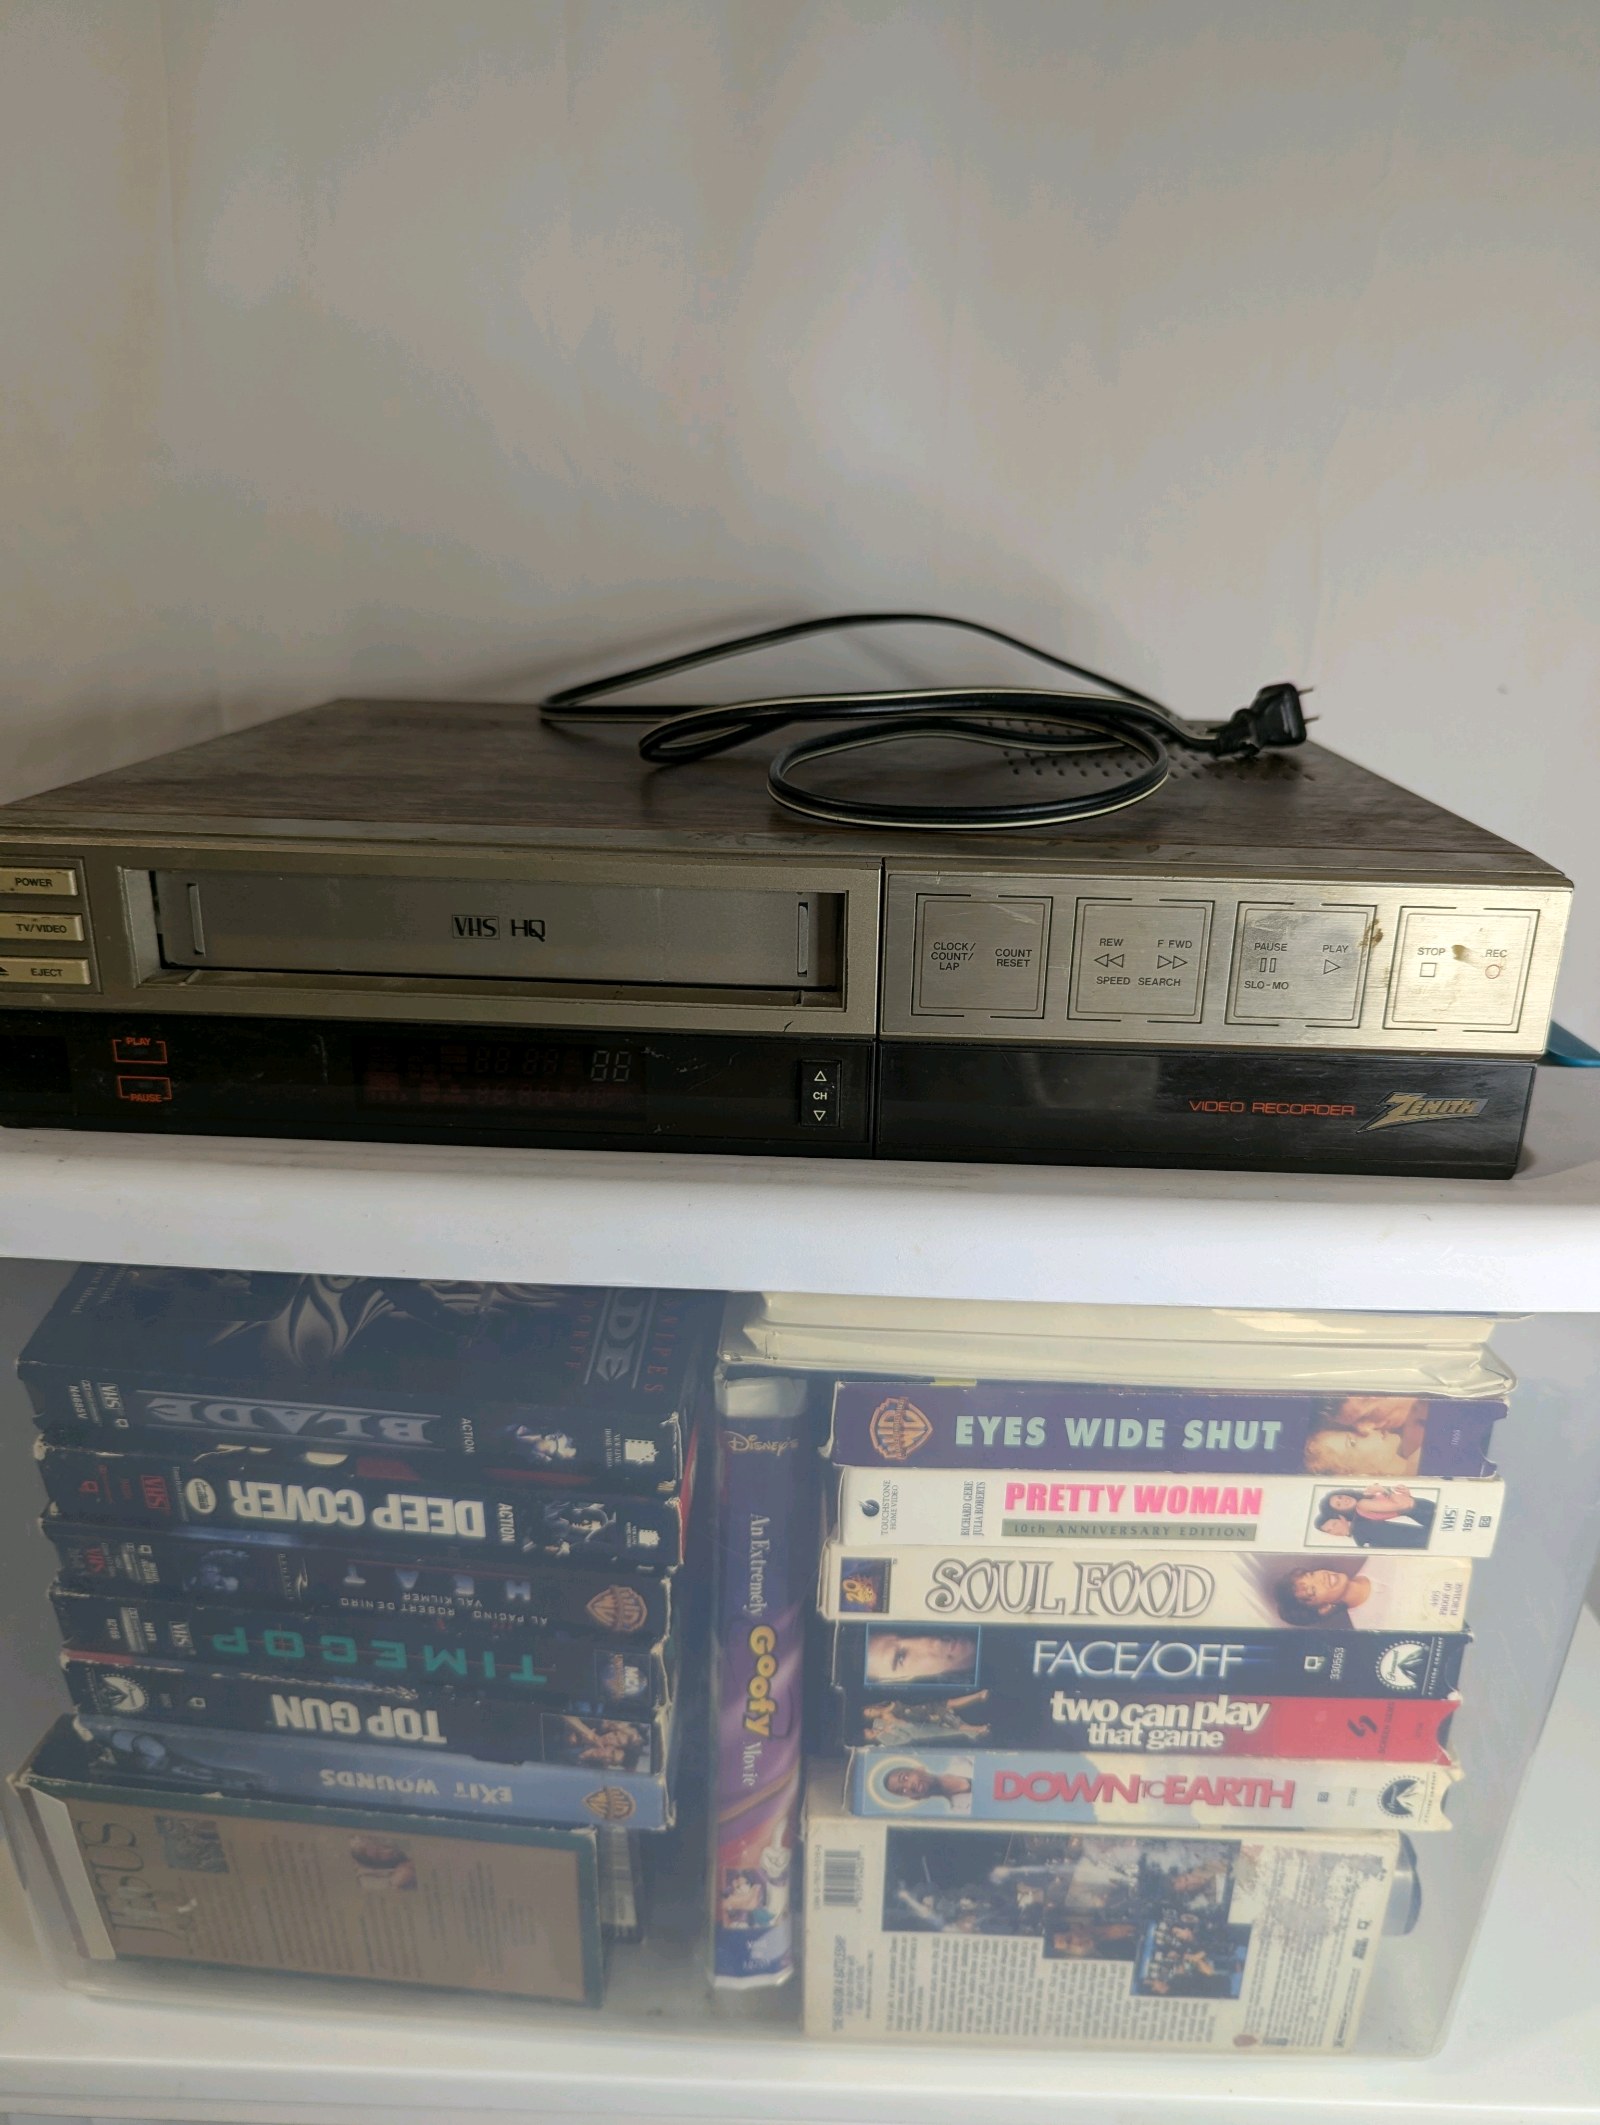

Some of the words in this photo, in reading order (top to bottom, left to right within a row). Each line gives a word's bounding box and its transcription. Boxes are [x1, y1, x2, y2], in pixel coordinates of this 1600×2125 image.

[15, 876, 53, 888] POWER
[16, 923, 67, 934] TV/VIDEO
[453, 916, 498, 939] VHS
[511, 918, 546, 942] HQ
[933, 942, 976, 952] CLOCK/
[995, 948, 1033, 959] COUNT
[1099, 937, 1124, 947] REW
[1157, 939, 1165, 949] F
[1168, 940, 1193, 950] FWD
[1253, 942, 1288, 952] PAUSE
[1322, 944, 1349, 954] PLAY
[1417, 947, 1446, 957] STOP
[1485, 949, 1508, 958] REC
[931, 952, 975, 962] COUNT/
[939, 961, 960, 971] LAP
[996, 958, 1031, 969] RESET
[30, 967, 64, 978] EJECT
[1096, 976, 1131, 986] SPEED
[1137, 977, 1182, 987] SEARCH
[125, 1036, 152, 1047] PLAY
[129, 1093, 163, 1103] PAUSE
[813, 1091, 828, 1100] CH
[1189, 1100, 1245, 1113] VIDEO
[1251, 1102, 1357, 1116] RECORDER
[99, 1383, 122, 1409] VHS
[146, 1397, 433, 1445] BLADE
[955, 1415, 1047, 1447] EYES
[1064, 1417, 1166, 1449] WIDE
[1182, 1419, 1283, 1451] SHUT
[460, 1417, 475, 1453] ACTION
[227, 1480, 366, 1527] COVER
[880, 1479, 891, 1537] TOUCHSTONE
[974, 1481, 986, 1514] ROBERTS
[1004, 1482, 1127, 1514] PRETTY
[1134, 1484, 1263, 1517] WOMAN
[372, 1493, 486, 1538] DEEP
[498, 1502, 516, 1543] ACTION
[750, 1512, 771, 1537] An
[960, 1502, 973, 1537] RICHARD
[972, 1515, 986, 1537] JULIA
[1440, 1506, 1458, 1532] VHS
[1462, 1509, 1476, 1533] 19377
[1013, 1523, 1046, 1535] 10th
[1055, 1523, 1169, 1537] ANNIVERSARY
[1179, 1526, 1248, 1538] EDITION
[344, 1565, 532, 1600] HEAT
[743, 1539, 771, 1617] Extremely
[926, 1557, 1065, 1615] SOUL
[1071, 1560, 1216, 1618] FOOD
[401, 1603, 456, 1616] ROBERT
[402, 1592, 453, 1604] KILMER
[457, 1598, 483, 1608] VAL
[1439, 1593, 1451, 1615] PROOF
[1450, 1581, 1463, 1616] PURCHASE
[473, 1610, 524, 1623] PACINO
[531, 1615, 548, 1625] AL
[169, 1621, 192, 1648] VHS
[211, 1626, 547, 1684] TIMECOP
[1032, 1639, 1245, 1679] FACE/OFF
[1330, 1646, 1345, 1681] 330553
[743, 1624, 778, 1738] Goofy
[270, 1693, 362, 1735] GUN
[1050, 1690, 1119, 1722] two
[1120, 1702, 1188, 1727] can
[1191, 1695, 1270, 1731] play
[367, 1705, 448, 1745] TOP
[1087, 1722, 1142, 1745] that
[1146, 1729, 1225, 1749] game
[742, 1741, 763, 1787] Movie
[319, 1769, 440, 1796] WOUNDS
[453, 1781, 513, 1805] EXIT
[993, 1770, 1141, 1805] DOWN
[1163, 1774, 1296, 1809] EARTH
